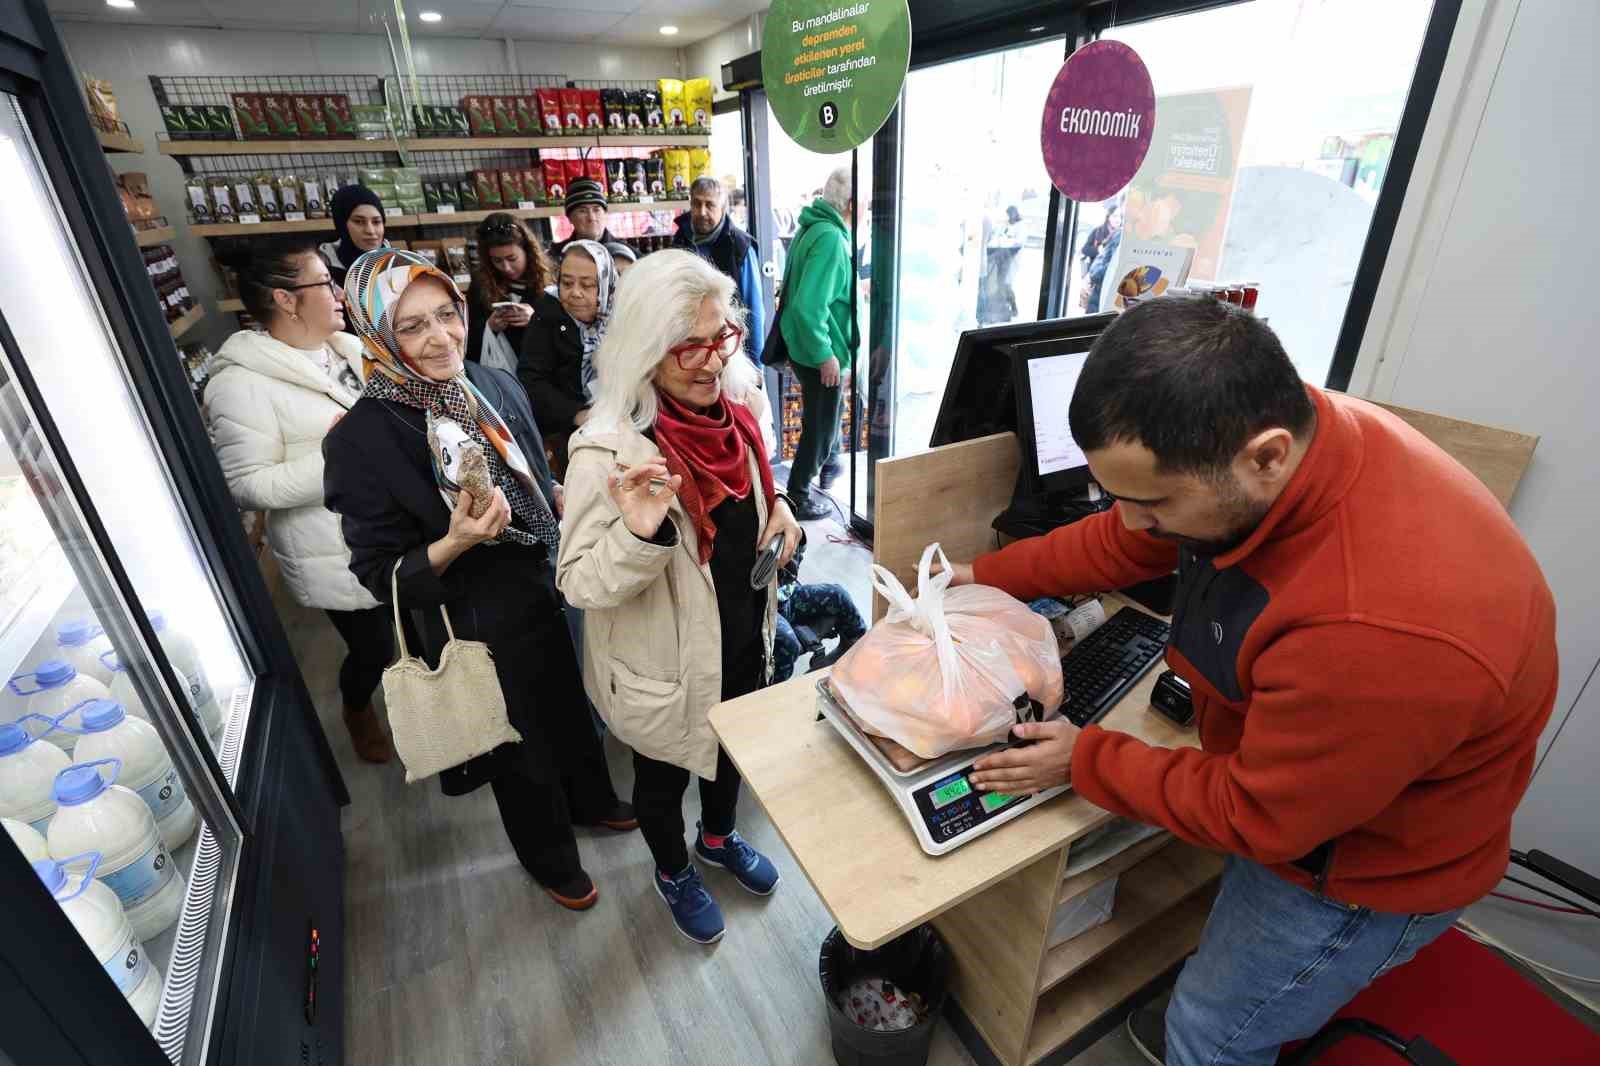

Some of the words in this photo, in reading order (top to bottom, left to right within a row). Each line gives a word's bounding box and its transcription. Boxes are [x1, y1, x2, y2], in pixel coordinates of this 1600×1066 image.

[792, 20, 804, 33] Bu
[806, 3, 869, 28] mandalinalar
[802, 25, 857, 46] depremden
[794, 47, 838, 66] etkilenen
[839, 38, 865, 58] yerel
[785, 68, 826, 84] üreticiler
[804, 77, 853, 96] üretilmiştir.
[823, 106, 833, 125] B
